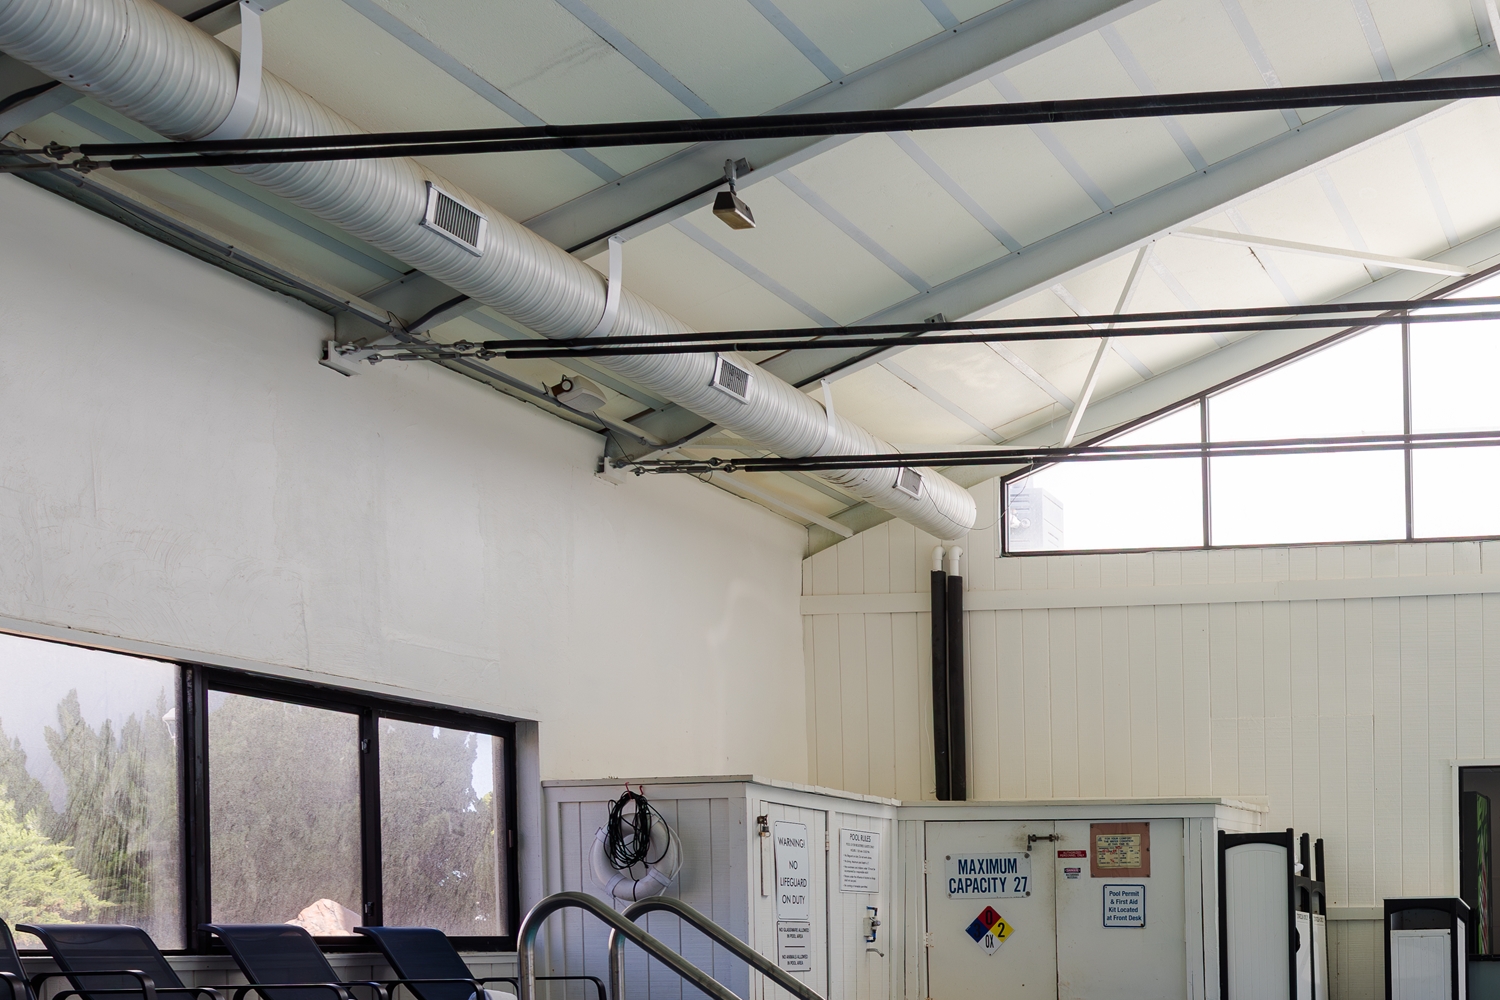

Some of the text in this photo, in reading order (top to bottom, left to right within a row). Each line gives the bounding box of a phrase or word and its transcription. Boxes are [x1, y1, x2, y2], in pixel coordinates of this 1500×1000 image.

[777, 837, 806, 848] WARNING!
[861, 835, 871, 843] RULES
[788, 860, 798, 870] NO
[958, 858, 1017, 875] MAXIMUM
[780, 877, 807, 888] LIFEGUARD
[949, 876, 1028, 894] CAPACITY 27
[782, 894, 805, 905] ON DUTY
[985, 910, 993, 926] 0
[973, 923, 981, 939] 3
[997, 922, 1005, 938] 2
[985, 934, 994, 948] OX
